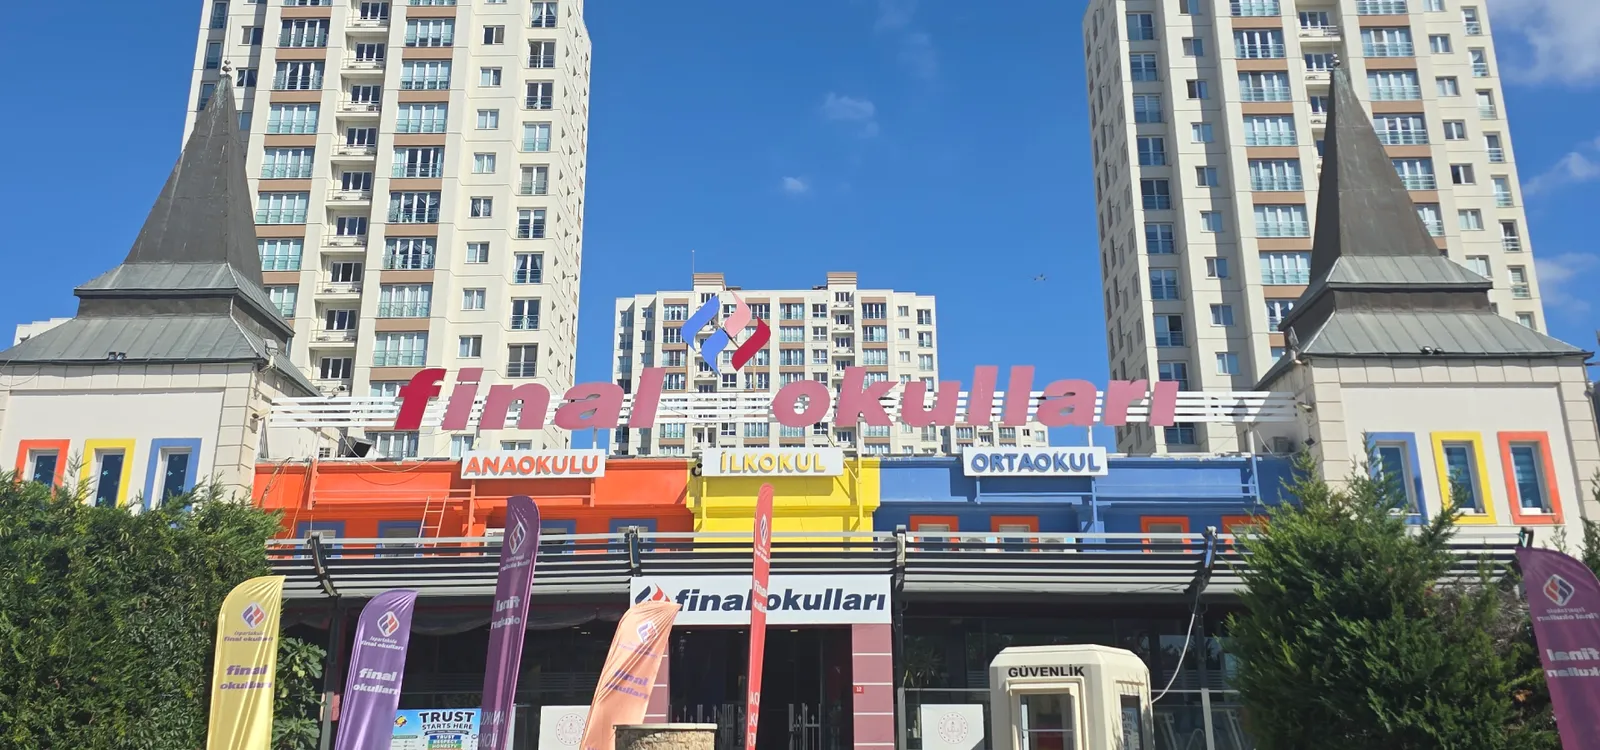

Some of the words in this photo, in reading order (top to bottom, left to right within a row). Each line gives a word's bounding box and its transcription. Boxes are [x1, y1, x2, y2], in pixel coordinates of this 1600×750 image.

[394, 367, 666, 430] final
[772, 365, 1179, 428] okulları
[463, 454, 599, 476] ANAOKULU
[720, 451, 826, 473] İLKOKUL
[971, 452, 1102, 473] ORTAOKUL
[675, 588, 753, 612] final
[766, 588, 886, 611] okulları
[226, 664, 268, 676] final
[359, 668, 398, 682] final
[1008, 664, 1085, 677] GÜVENLİK
[420, 711, 475, 723] TRUST
